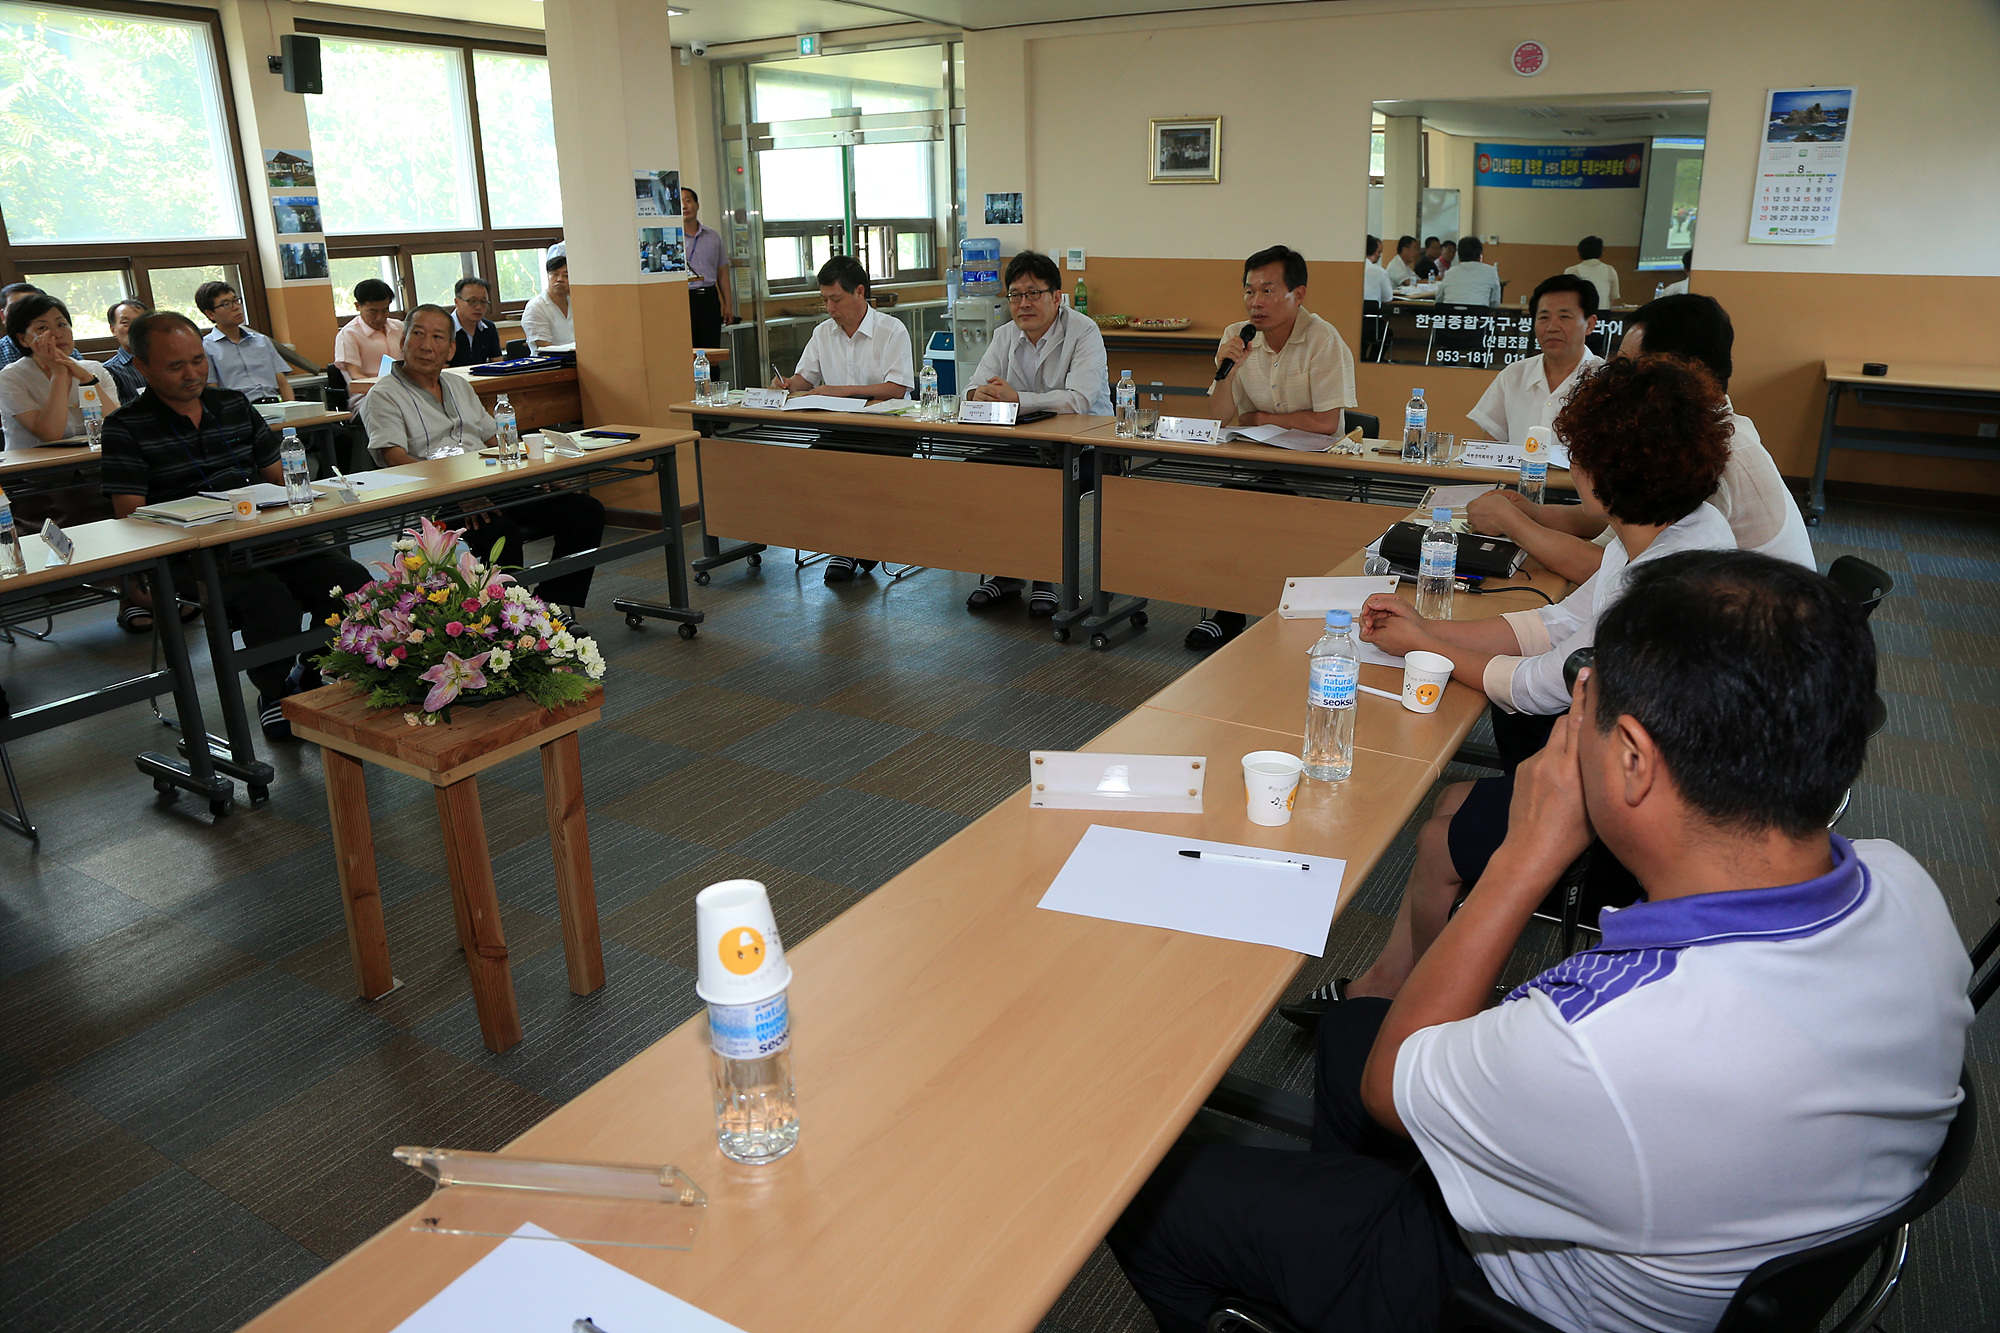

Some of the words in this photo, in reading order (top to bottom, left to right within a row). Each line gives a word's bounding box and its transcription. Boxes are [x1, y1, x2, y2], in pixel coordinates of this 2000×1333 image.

[1798, 165, 1804, 174] 8
[1415, 314, 1532, 332] 한일종합가구·씽
[1482, 334, 1529, 349] (산림조합
[1436, 350, 1494, 364] 953-1811
[1504, 352, 1526, 364] 011
[1324, 677, 1353, 686] natural
[1324, 683, 1354, 692] mineral
[1323, 698, 1354, 706] seoksu
